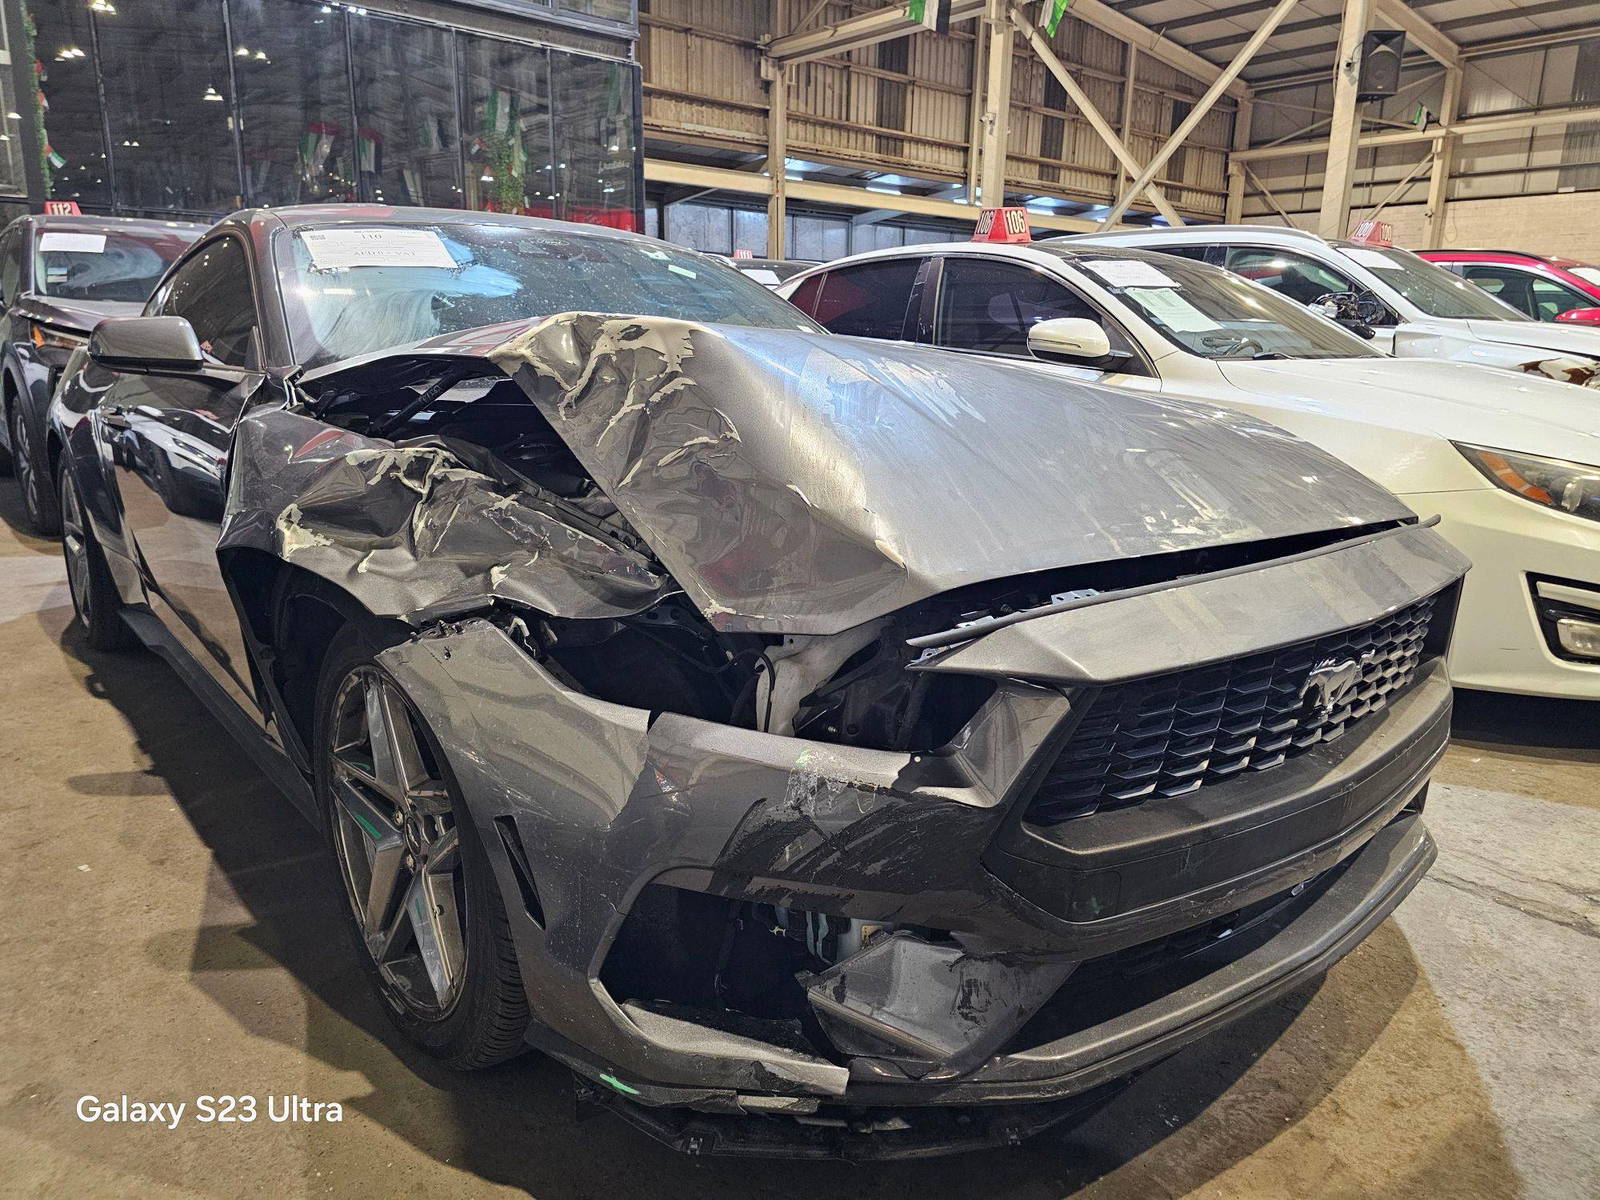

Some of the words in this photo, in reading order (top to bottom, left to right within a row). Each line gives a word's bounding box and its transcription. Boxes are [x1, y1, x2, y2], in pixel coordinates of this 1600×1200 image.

[51, 203, 73, 216] 112
[976, 210, 994, 234] 106
[1006, 210, 1026, 234] 106
